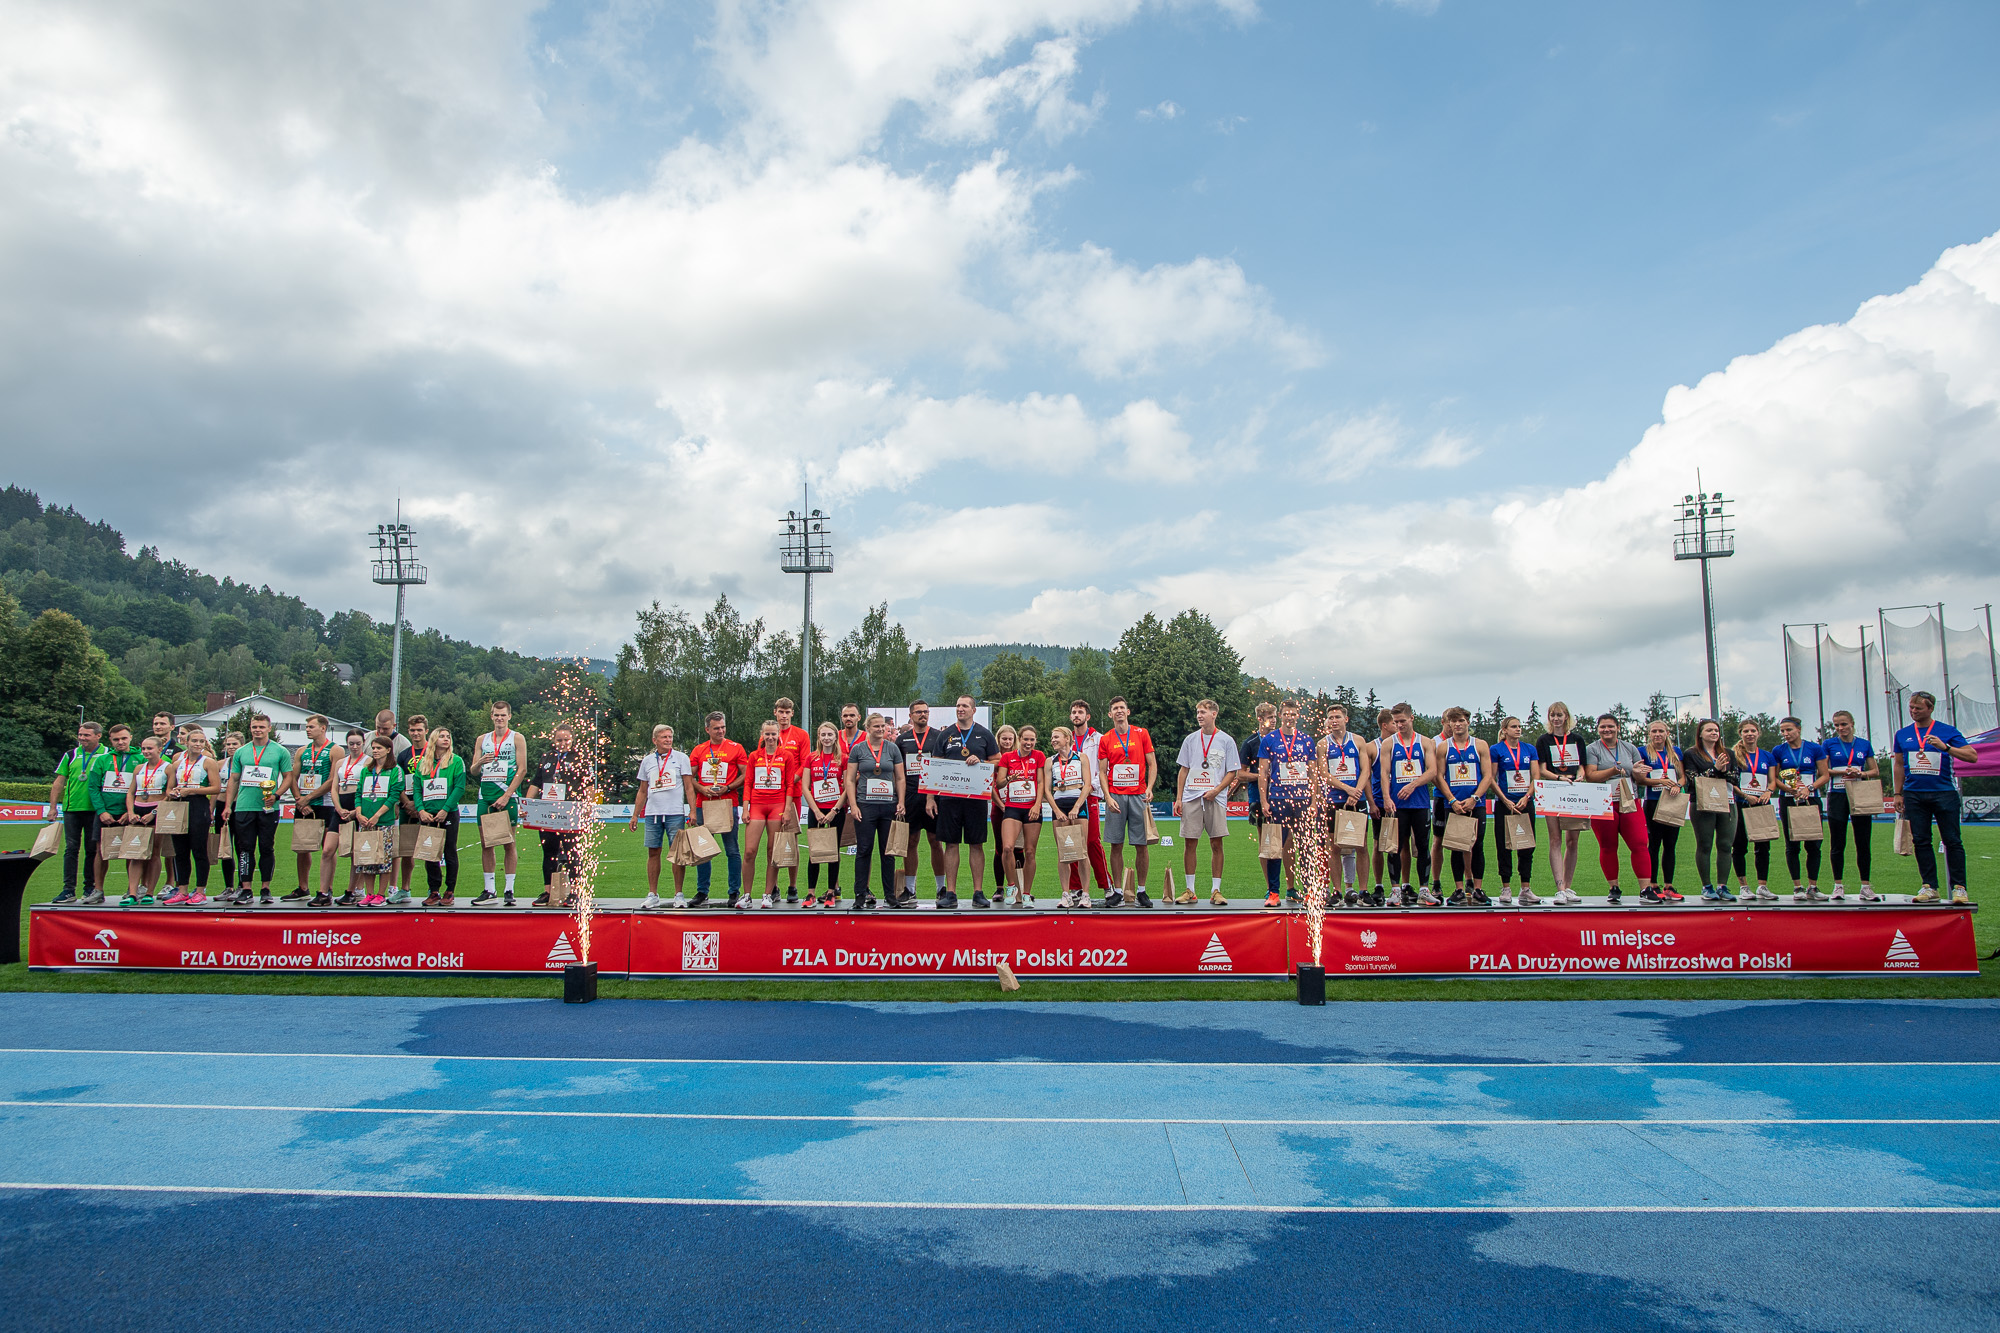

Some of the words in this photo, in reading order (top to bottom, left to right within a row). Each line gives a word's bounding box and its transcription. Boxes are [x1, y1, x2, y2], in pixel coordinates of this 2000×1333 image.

[283, 930, 292, 945] II
[297, 929, 362, 948] miejsce
[1580, 930, 1597, 946] III
[1602, 929, 1676, 949] miejsce
[77, 951, 116, 961] ORLEN
[181, 951, 218, 966] PZLA
[223, 951, 313, 969] Drużynowe
[317, 952, 412, 967] Mistrzostwa
[417, 952, 464, 968] Polski
[684, 957, 717, 969] PZLA
[782, 948, 829, 966] PZLA
[835, 948, 947, 970] Drużynowy
[952, 948, 1010, 967] Mistrz
[1016, 949, 1073, 967] Polski
[1079, 949, 1128, 967] 2022
[1469, 954, 1512, 970] PZLA
[1518, 953, 1621, 973] Drużynowe
[1626, 953, 1733, 969] Mistrzostwa
[1739, 952, 1792, 969] Polski
[1345, 963, 1365, 971] Sportu
[1369, 963, 1397, 971] Turystyki
